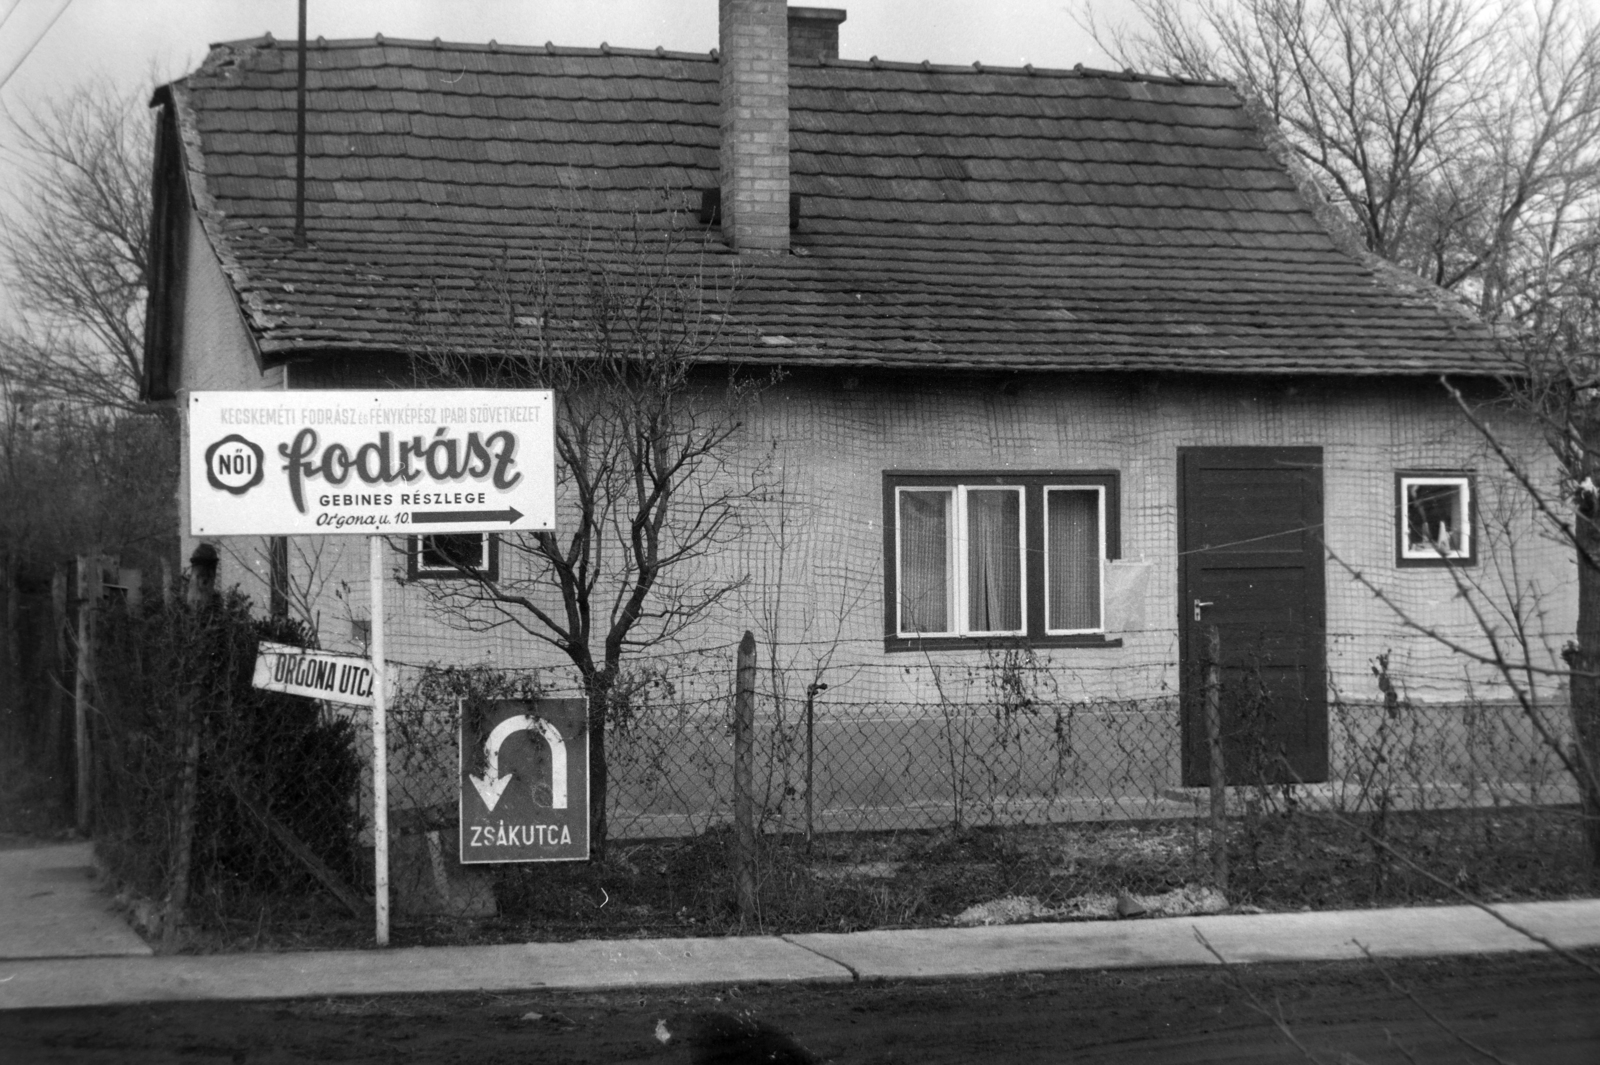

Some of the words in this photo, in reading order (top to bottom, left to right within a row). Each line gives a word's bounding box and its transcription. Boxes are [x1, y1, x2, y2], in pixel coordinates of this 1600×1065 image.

[220, 404, 296, 425] KECSKEMÉTI
[301, 404, 357, 425] FODRÁSZ
[369, 403, 437, 425] FÉNYKÉPÉSZ
[440, 406, 467, 424] IPARI
[470, 403, 541, 424] SZÖVETKEZET
[218, 448, 252, 475] NŐI
[319, 494, 393, 507] GEBINES
[401, 490, 486, 505] RÉSZLEGE
[316, 512, 377, 529] Orgona
[379, 514, 391, 525] u.
[274, 654, 337, 692] ORGONA
[470, 819, 572, 847] ZSÁKUTCA
